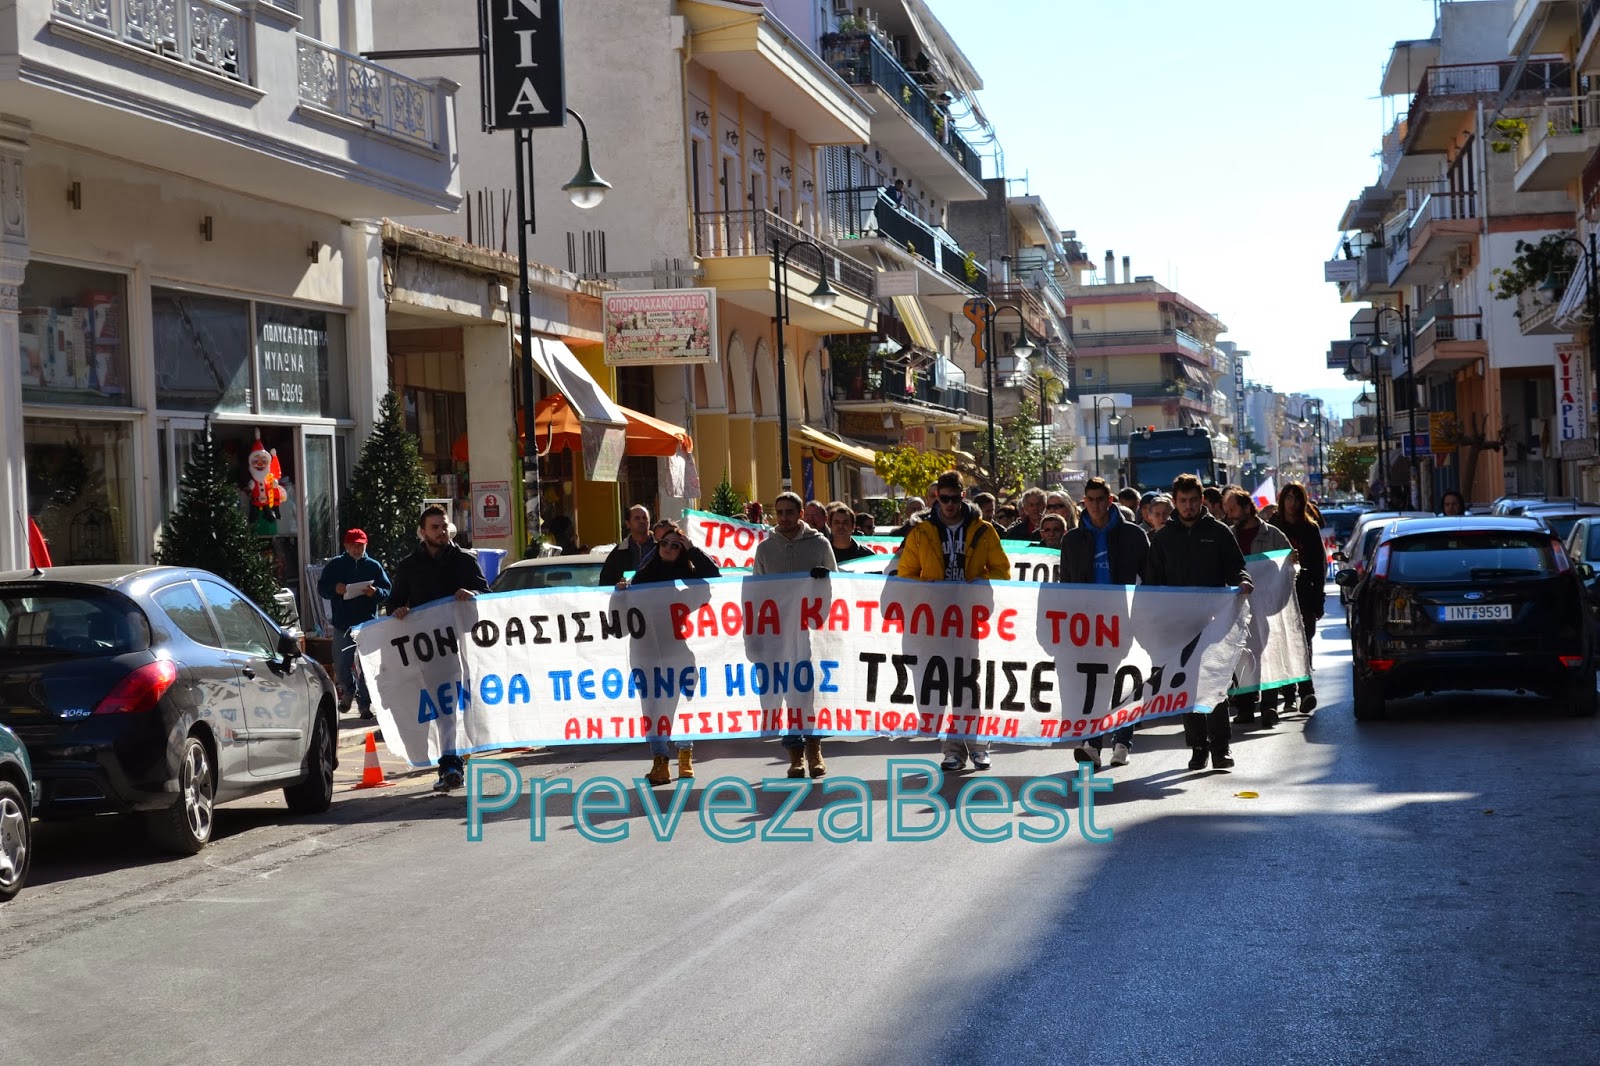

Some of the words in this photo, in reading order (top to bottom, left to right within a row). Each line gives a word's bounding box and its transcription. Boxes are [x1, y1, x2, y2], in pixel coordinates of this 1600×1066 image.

[609, 295, 706, 312] ΟΠΟΡΟΛΑΧΑΝΟΠΩΛΕΙΟ
[263, 324, 328, 347] ΠΟΛΥΚΑΤΑΣΤΗΜΑ
[264, 350, 304, 373] ΜΥΛΩΝΑ
[1235, 358, 1244, 400] HOTEL
[391, 626, 458, 667] ΤΟΝ
[471, 607, 646, 648] ΦΑΣΙΣΜΟ
[670, 599, 781, 641] ΒΑΘΙΑ
[801, 597, 1018, 641] ΚΑΤΑΛΑΒΕ
[1046, 610, 1120, 648] ΤΟΝ
[480, 673, 530, 705] ΘΑ
[548, 666, 708, 702] ΠΕΘΑΝΕΙ
[725, 660, 839, 696] ΜΟΝΟΣ
[859, 652, 1056, 713] ΤΣΑΚΙΣΕ
[1040, 691, 1189, 738] ΠΡΩΤΟΒΟΥΛΙΑ
